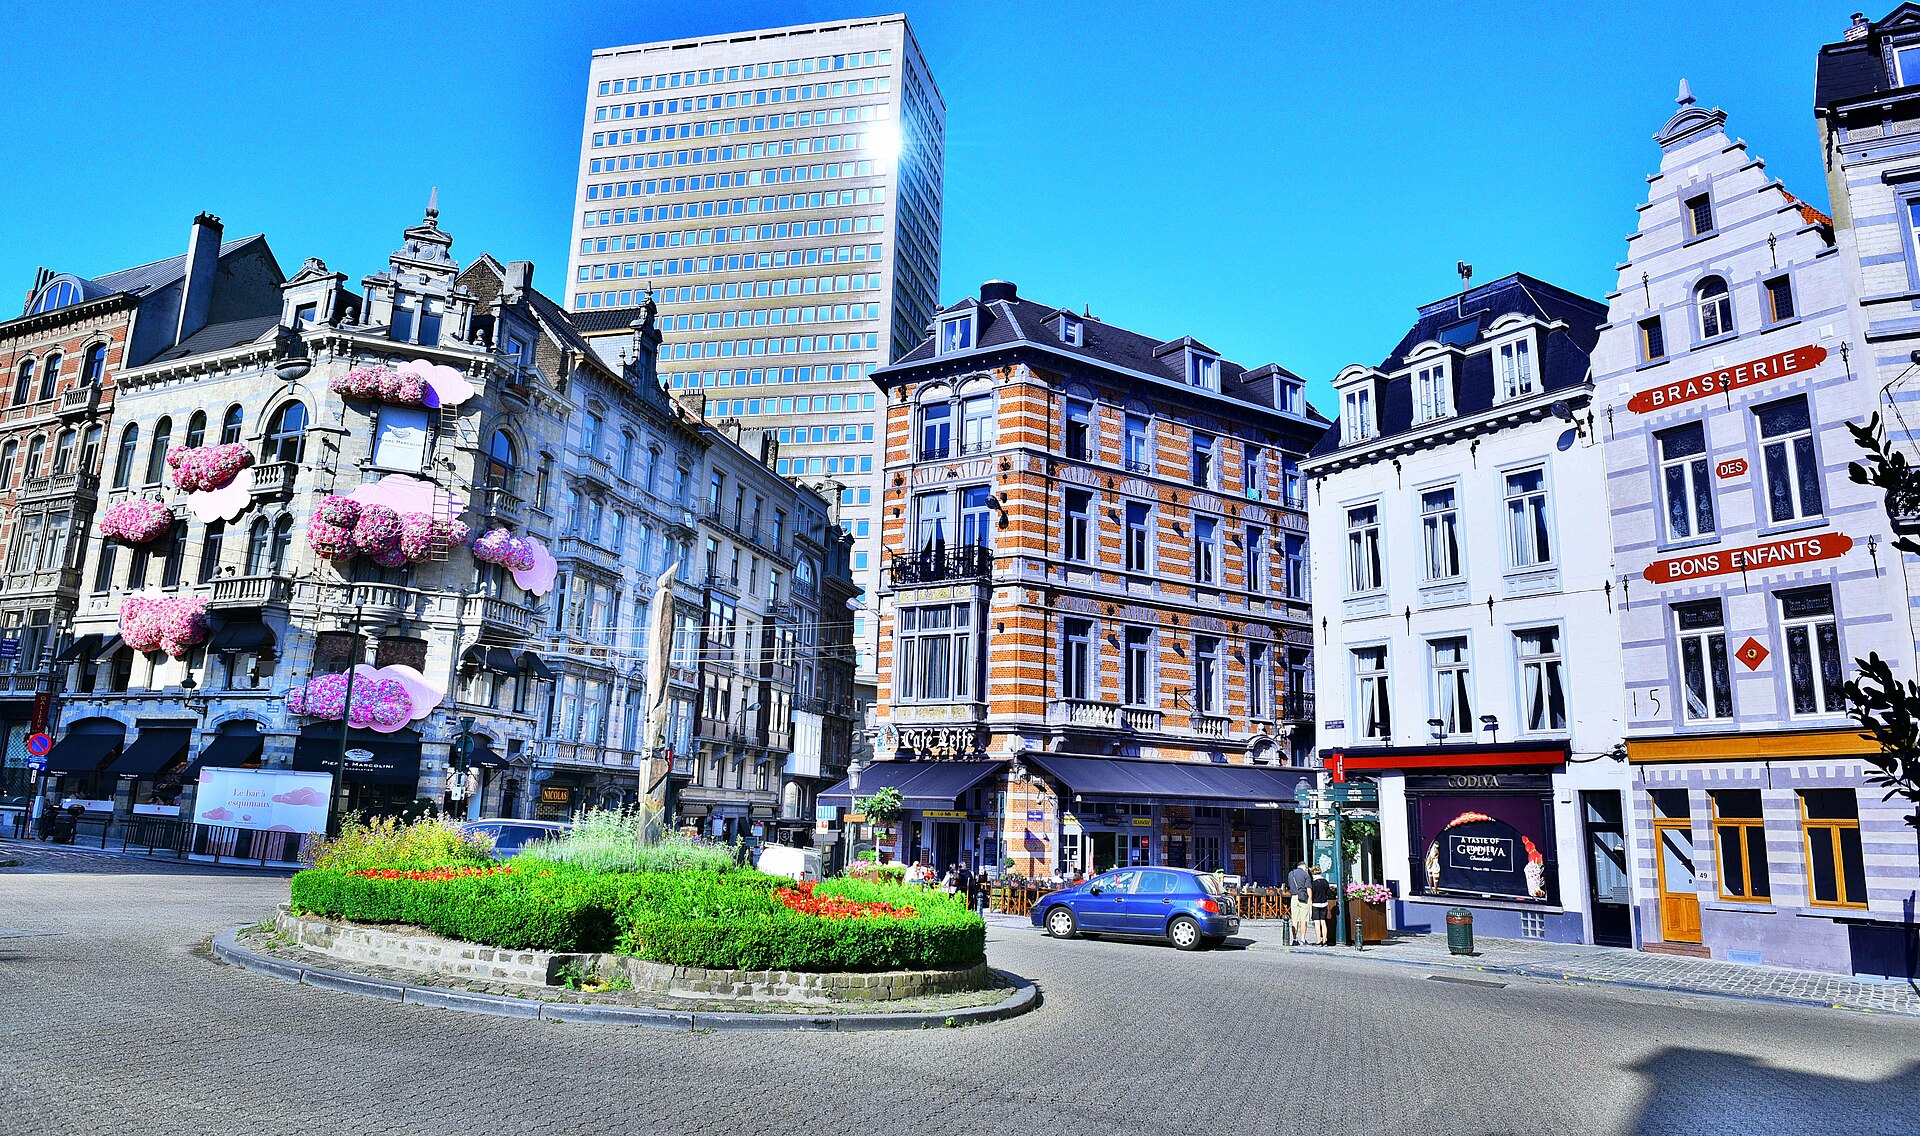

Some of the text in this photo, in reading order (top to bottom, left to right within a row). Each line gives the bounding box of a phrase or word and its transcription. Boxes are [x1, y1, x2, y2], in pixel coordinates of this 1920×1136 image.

[1652, 353, 1797, 406] BRASSERIE
[1720, 464, 1744, 476] DES
[1668, 538, 1822, 578] BONS ENFANTS
[37, 695, 47, 728] GALLERY
[901, 727, 975, 751] Café Leffe
[1448, 775, 1501, 788] GODIVA
[233, 788, 243, 796] Le
[246, 789, 259, 797] bar
[544, 790, 567, 800] NICOLAS
[227, 799, 271, 808] esquimaux
[1468, 837, 1488, 845] TASTE
[1457, 844, 1507, 858] GODIVA
